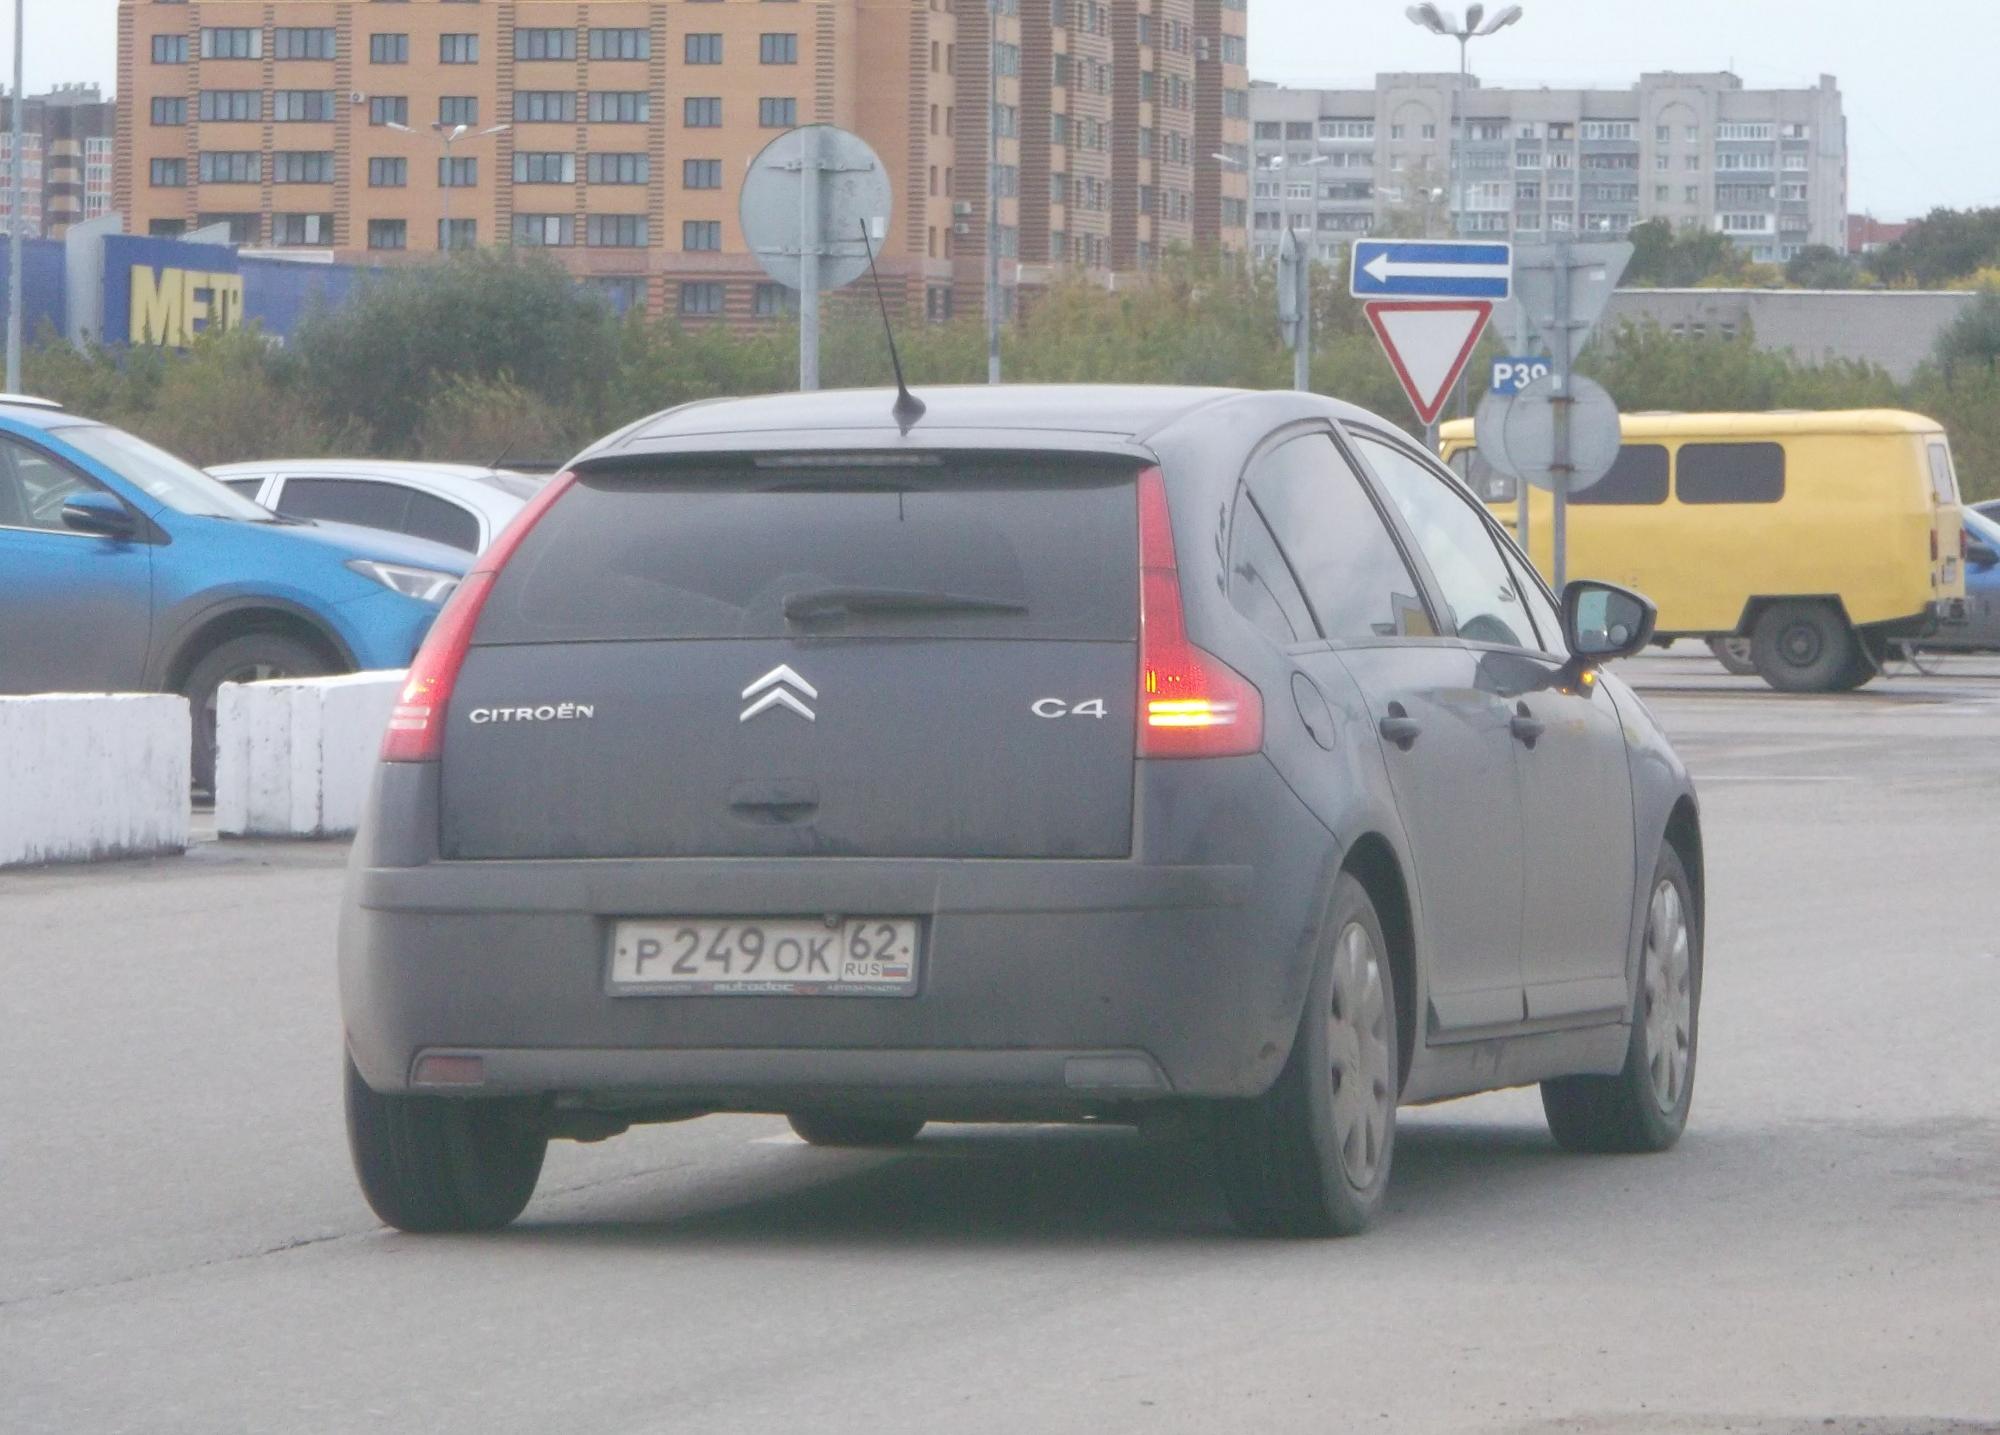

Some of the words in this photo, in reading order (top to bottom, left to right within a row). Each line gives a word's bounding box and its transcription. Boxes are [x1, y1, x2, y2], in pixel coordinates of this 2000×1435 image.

[469, 702, 594, 724] CITROËN
[1031, 698, 1107, 719] C4
[849, 924, 897, 960] 62
[845, 962, 880, 976] RUS
